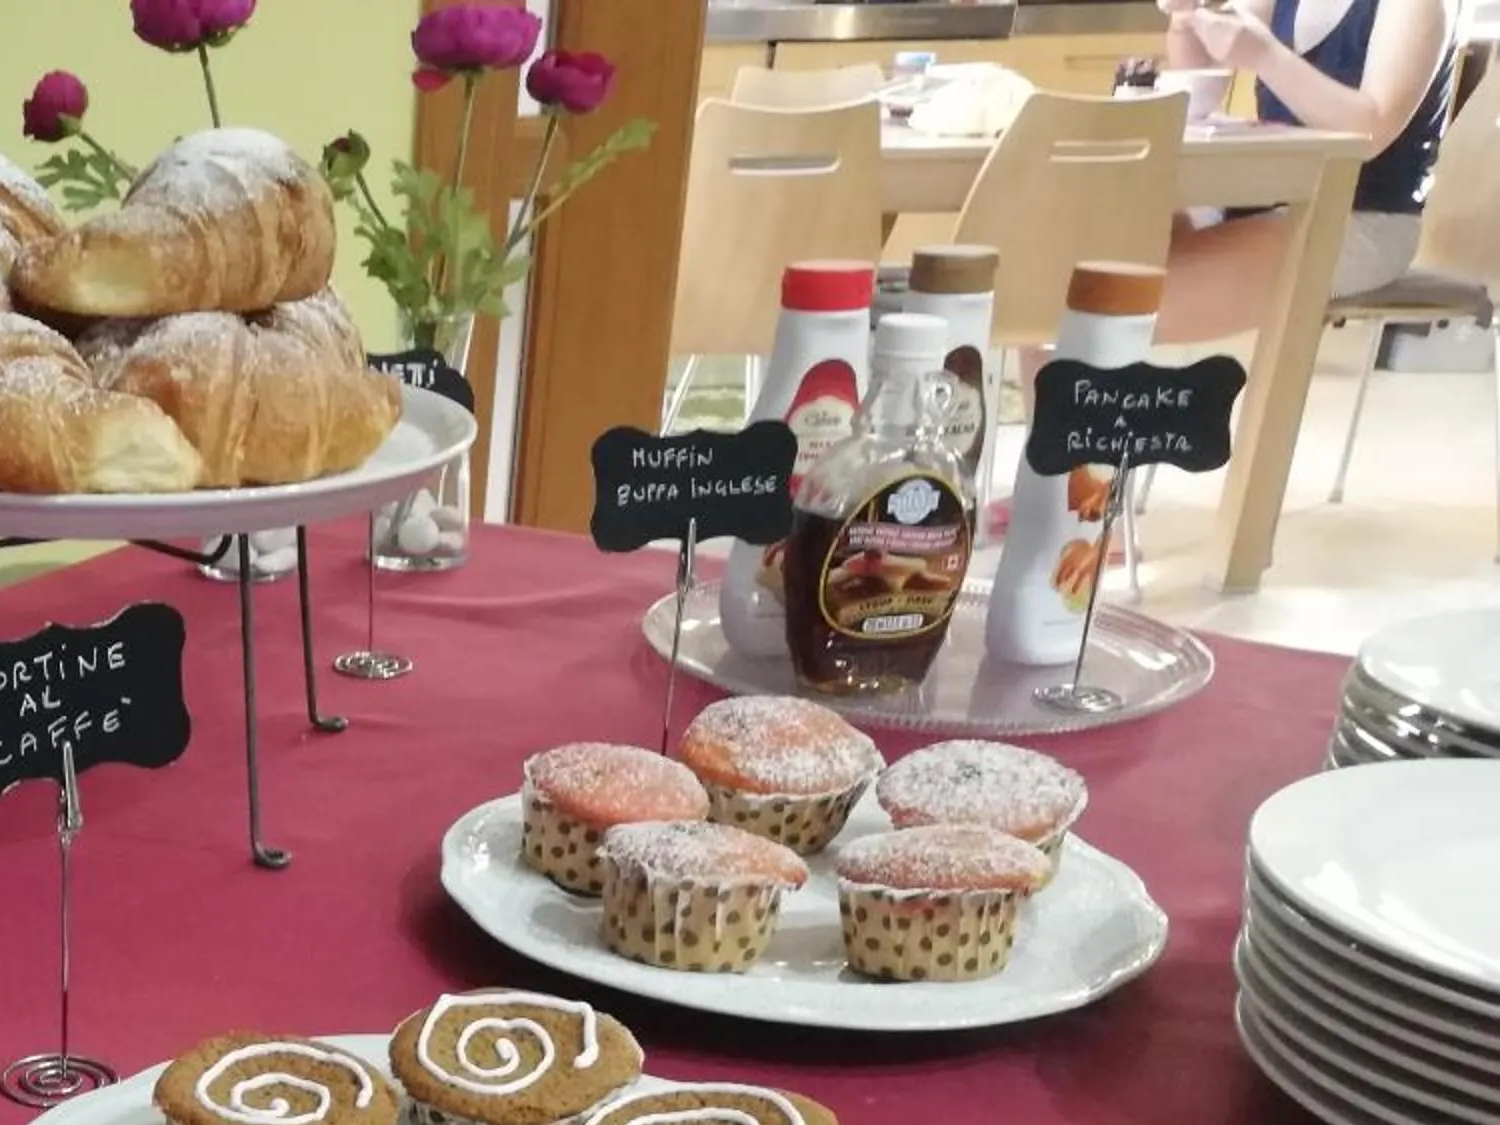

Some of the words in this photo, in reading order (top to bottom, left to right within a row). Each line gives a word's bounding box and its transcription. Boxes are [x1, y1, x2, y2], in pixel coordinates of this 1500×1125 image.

[1074, 379, 1193, 410] PANCAKE
[1067, 427, 1192, 454] RICHIESTA
[632, 445, 713, 469] MUFFIN
[691, 475, 777, 499] INGLESE
[19, 685, 61, 717] AL
